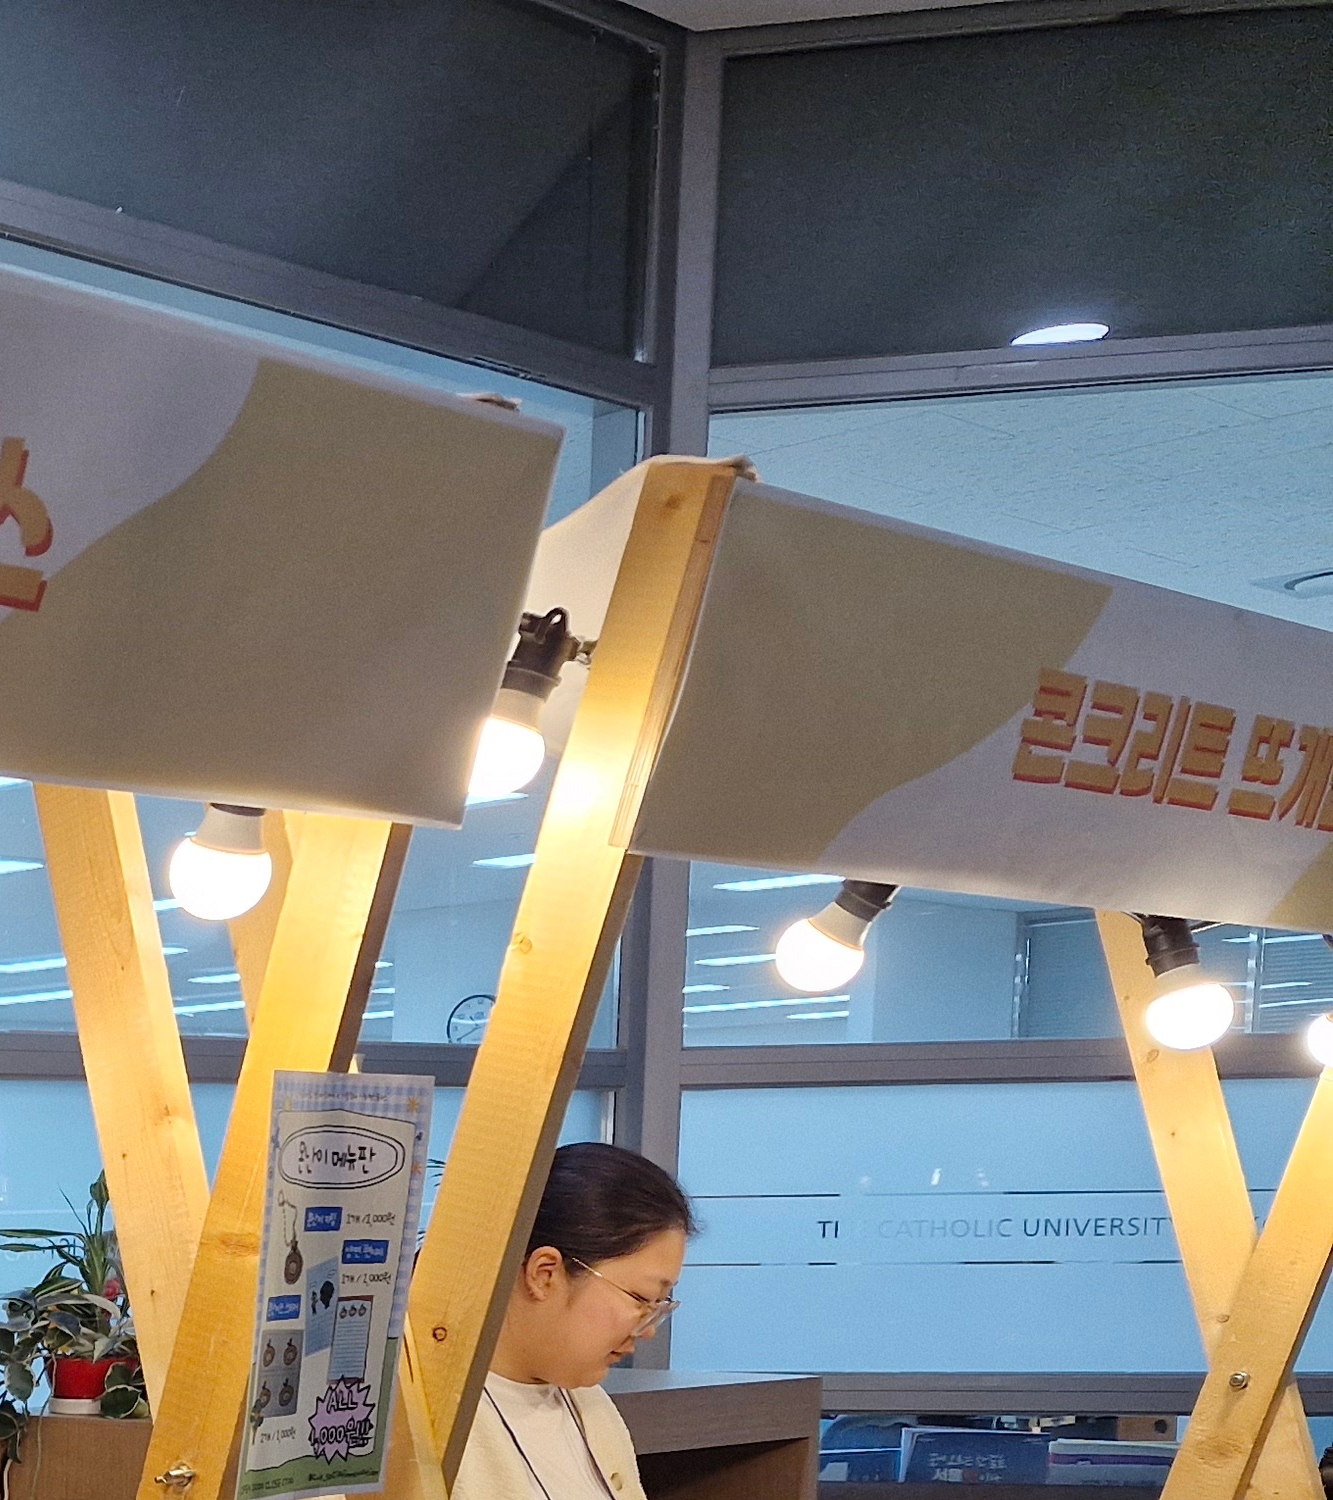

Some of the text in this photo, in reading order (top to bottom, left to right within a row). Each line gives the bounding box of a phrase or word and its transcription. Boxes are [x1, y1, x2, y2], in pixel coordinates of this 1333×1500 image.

[1011, 667, 1236, 811] 콘크리트
[332, 1144, 376, 1174] 메뉴판
[878, 1219, 1013, 1239] CATHOLIC
[327, 1391, 358, 1414] ALL
